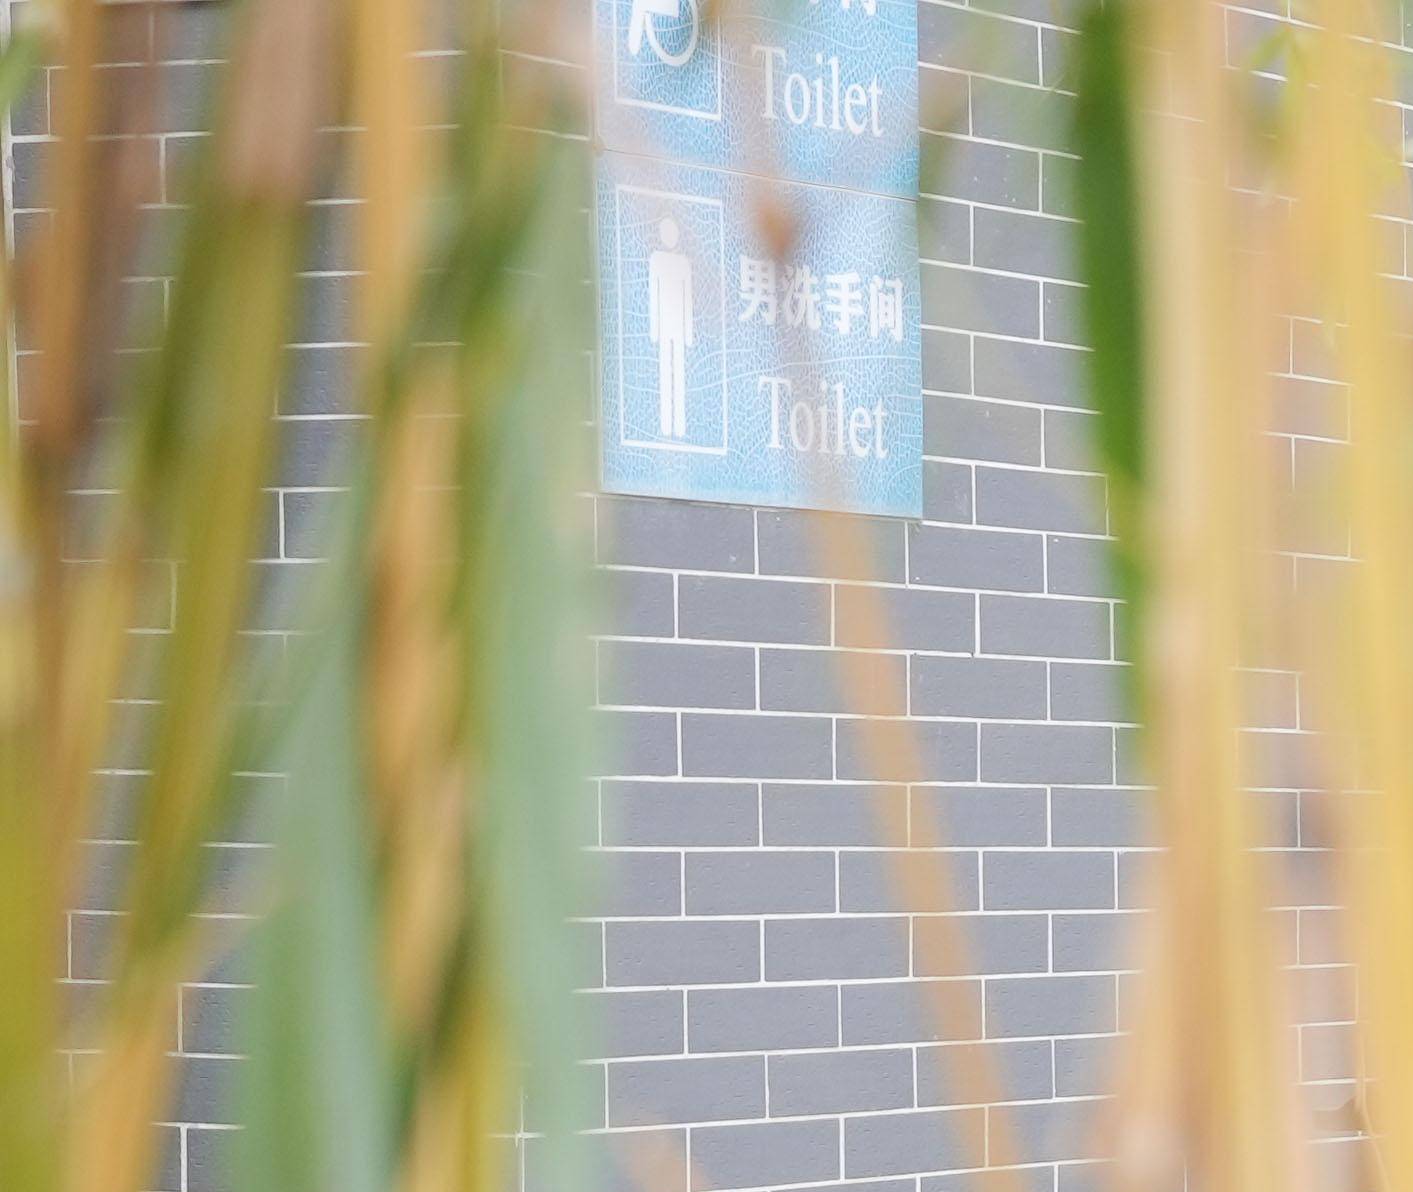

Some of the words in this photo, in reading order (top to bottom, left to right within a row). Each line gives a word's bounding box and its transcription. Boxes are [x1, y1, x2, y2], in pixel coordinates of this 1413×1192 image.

[753, 45, 884, 137] Toilet
[738, 256, 904, 341] 男洗手间
[758, 375, 889, 458] Toilet
